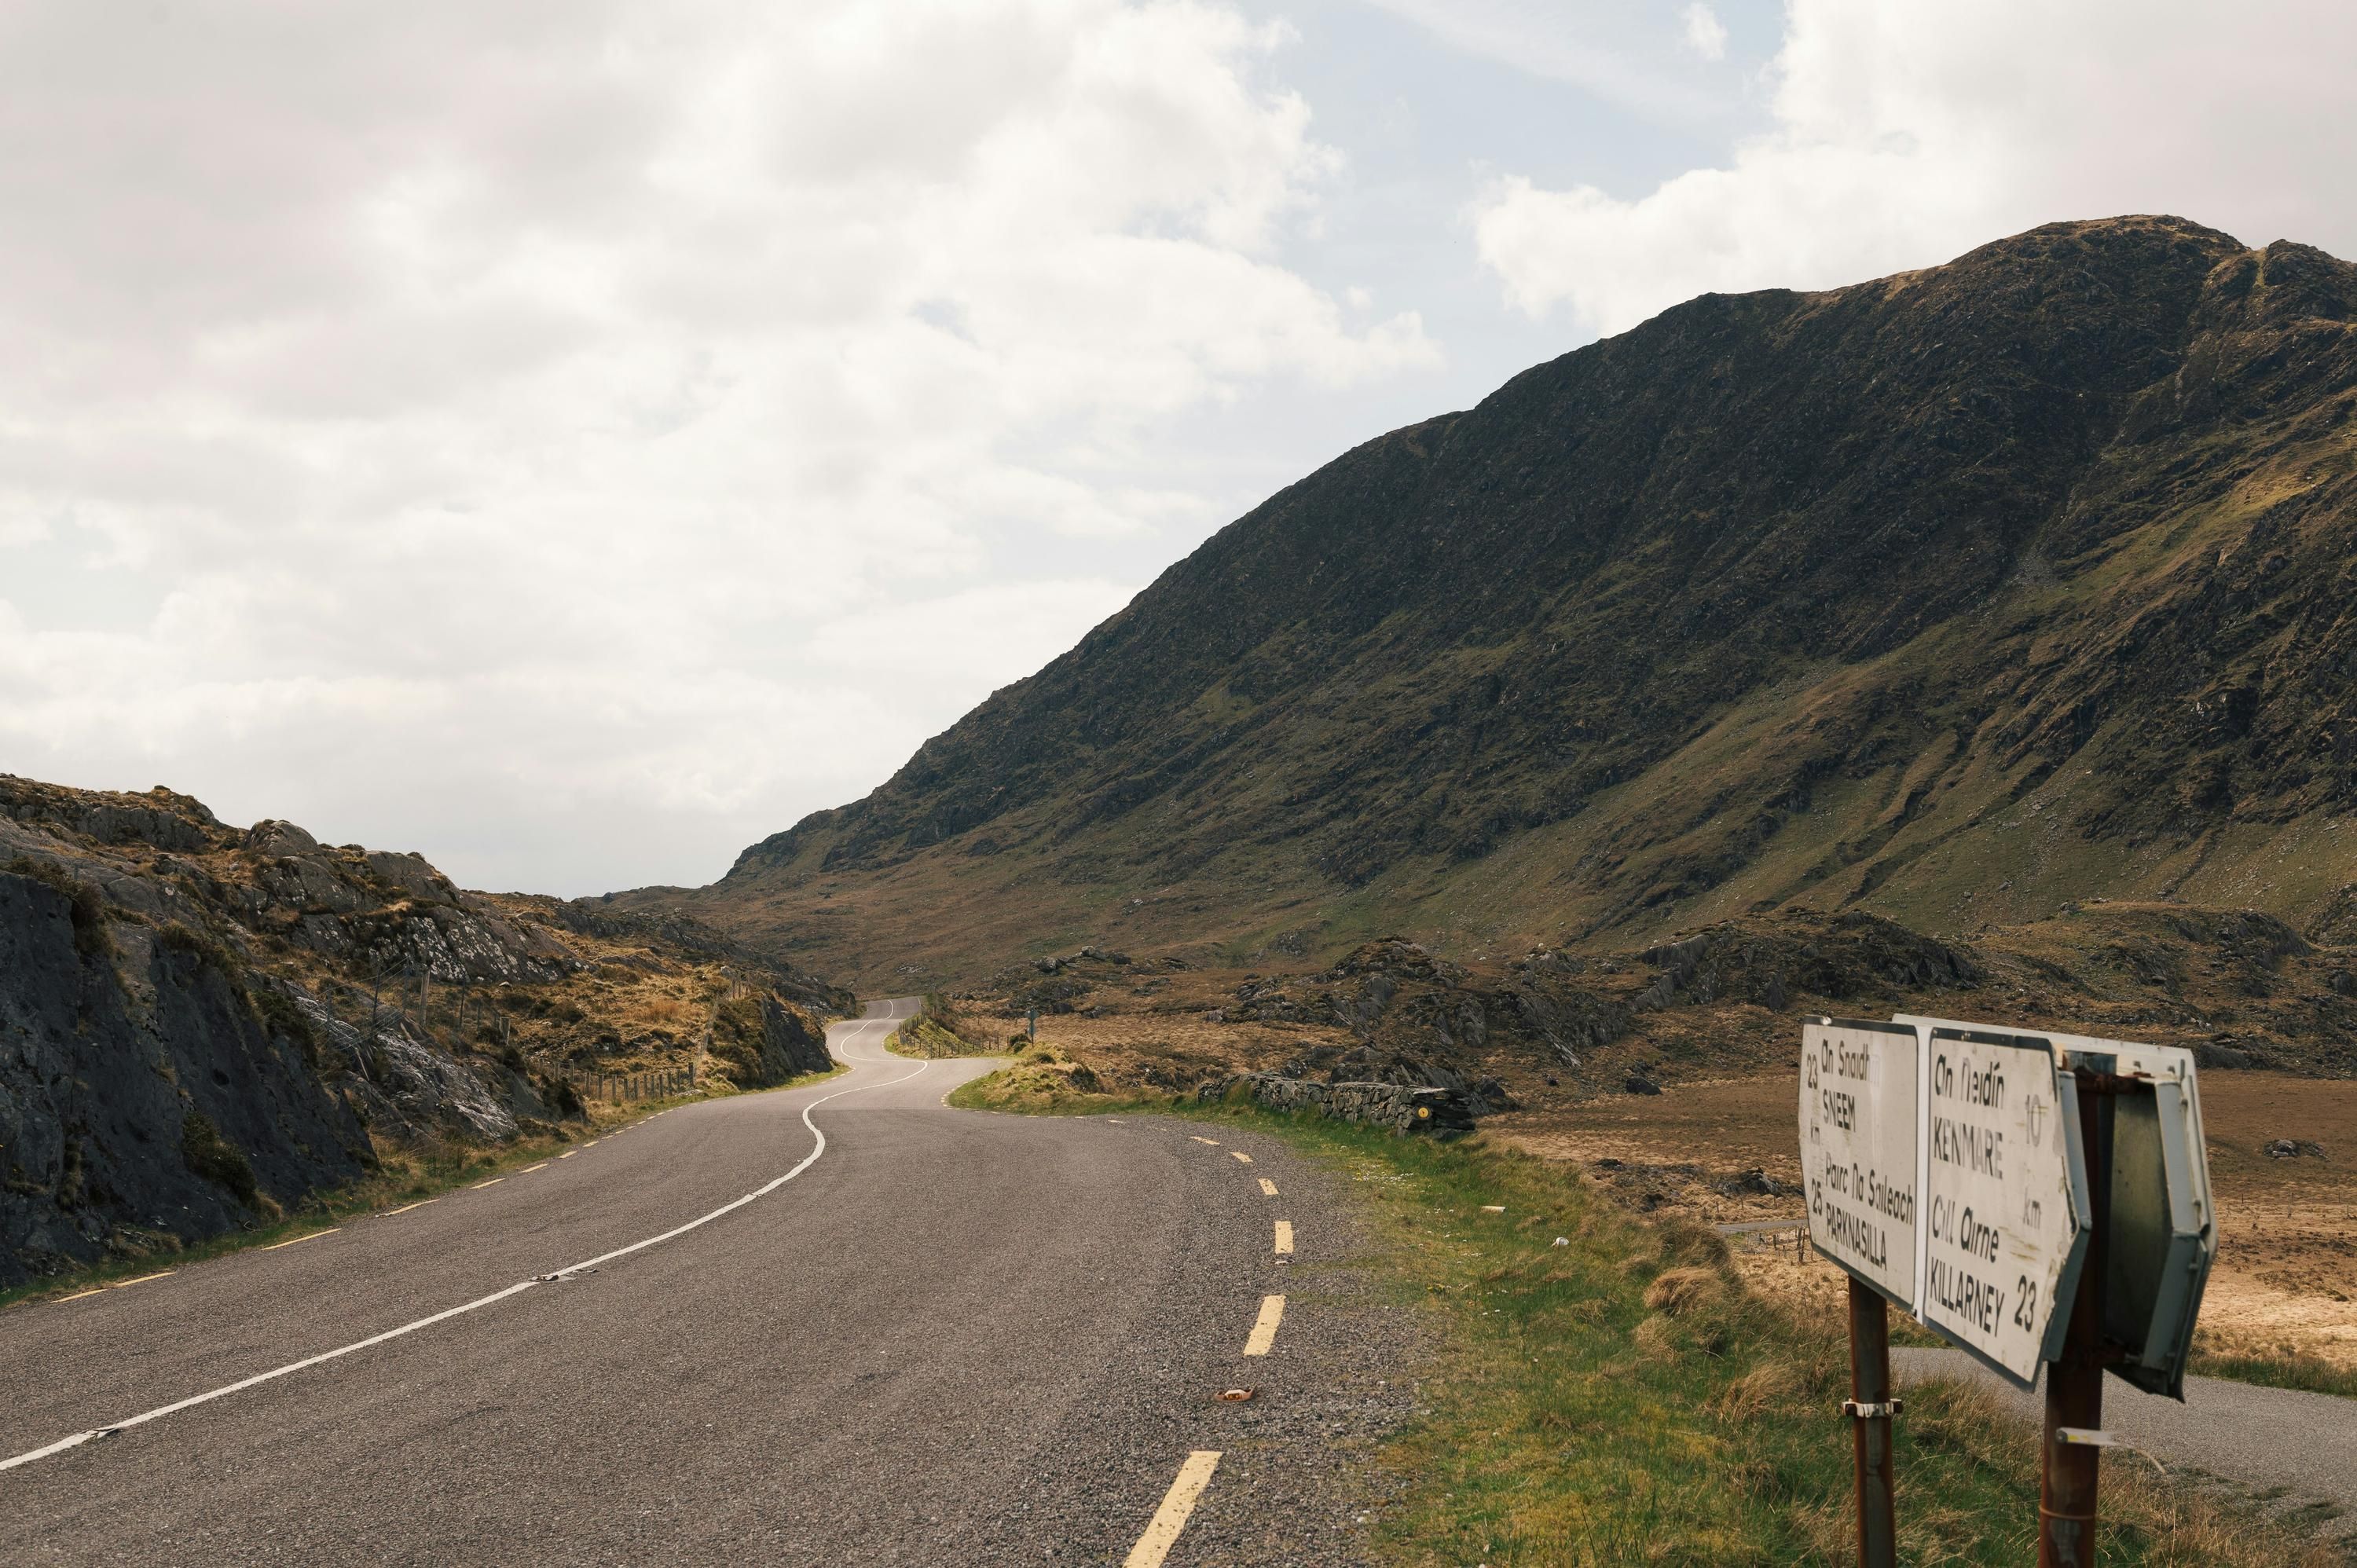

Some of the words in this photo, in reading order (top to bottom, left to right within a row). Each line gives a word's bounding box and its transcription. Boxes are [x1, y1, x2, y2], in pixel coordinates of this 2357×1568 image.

[1807, 1053, 1818, 1090] 23
[1810, 1118, 1820, 1145] km
[1823, 1089, 1856, 1132] SNEEM
[2025, 1094, 2042, 1148] 10
[1934, 1116, 2003, 1180] KENMARE
[1812, 1178, 1823, 1216] 25
[1933, 1194, 1956, 1245] Cill
[2023, 1186, 2041, 1230] km
[1827, 1202, 1887, 1271] PARKNASILLA
[1930, 1256, 2005, 1338] KILLARNEY
[2014, 1274, 2036, 1333] 23
